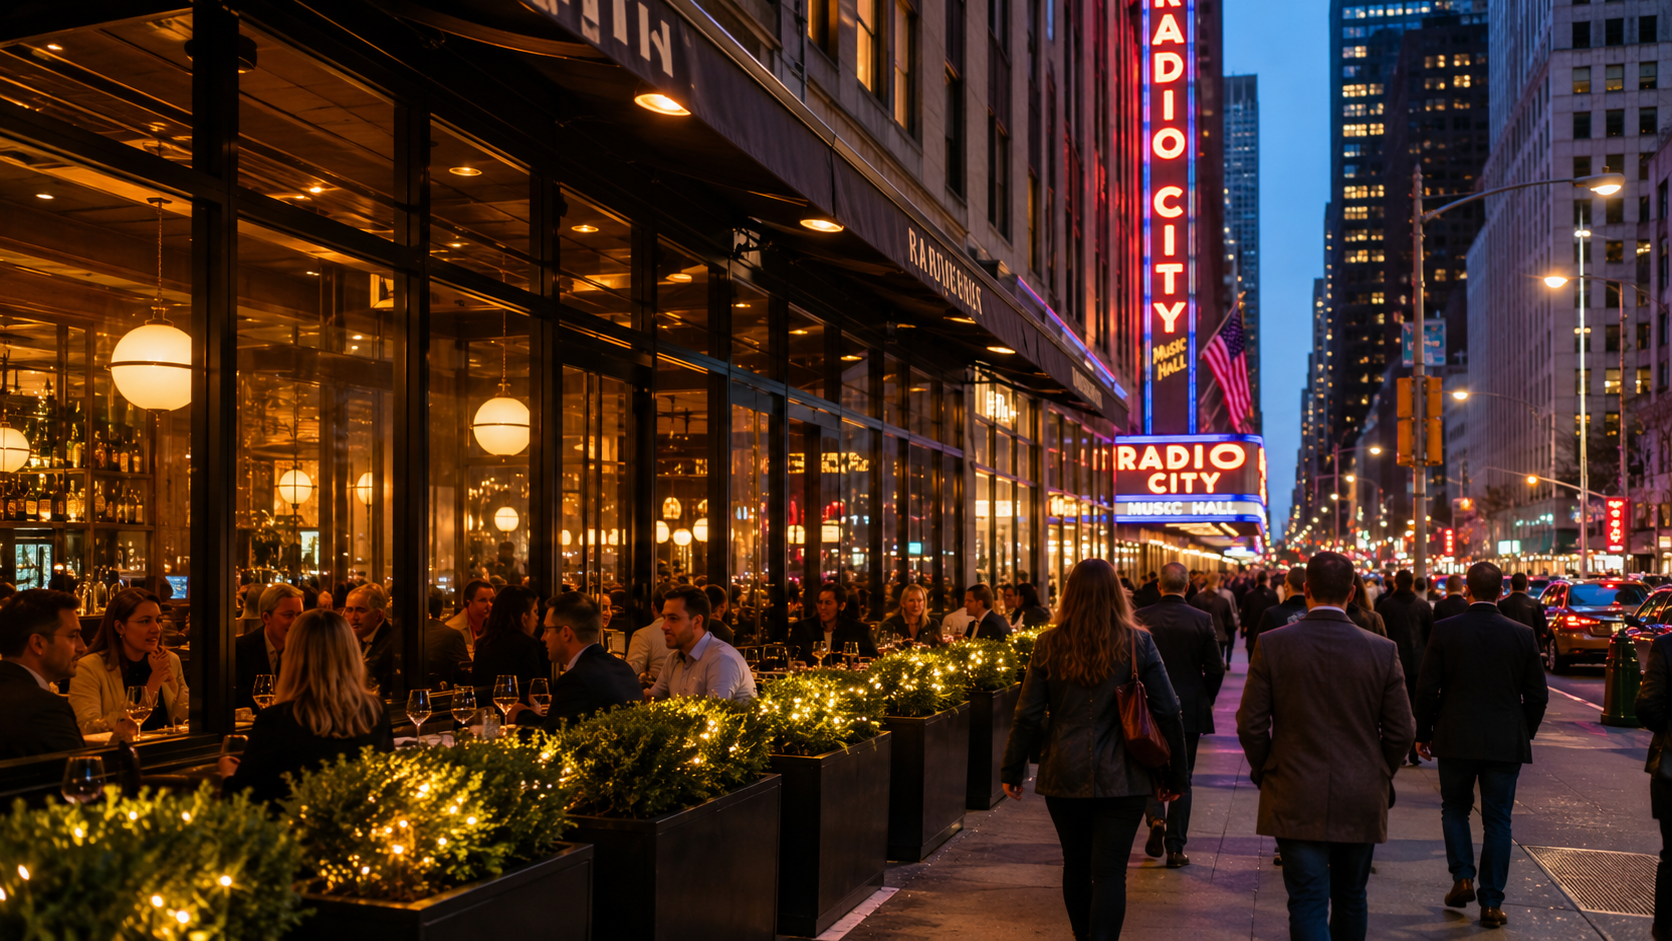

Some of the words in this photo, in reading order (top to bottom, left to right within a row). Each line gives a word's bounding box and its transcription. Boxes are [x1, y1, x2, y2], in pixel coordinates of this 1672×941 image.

[1152, 0, 1186, 160] ADIO
[1153, 186, 1186, 333] CITY
[1153, 337, 1187, 365] MUSIC
[1157, 354, 1187, 381] HALL
[1117, 443, 1246, 471] RADIO
[1148, 472, 1221, 494] CITY
[1191, 501, 1238, 516] HALL
